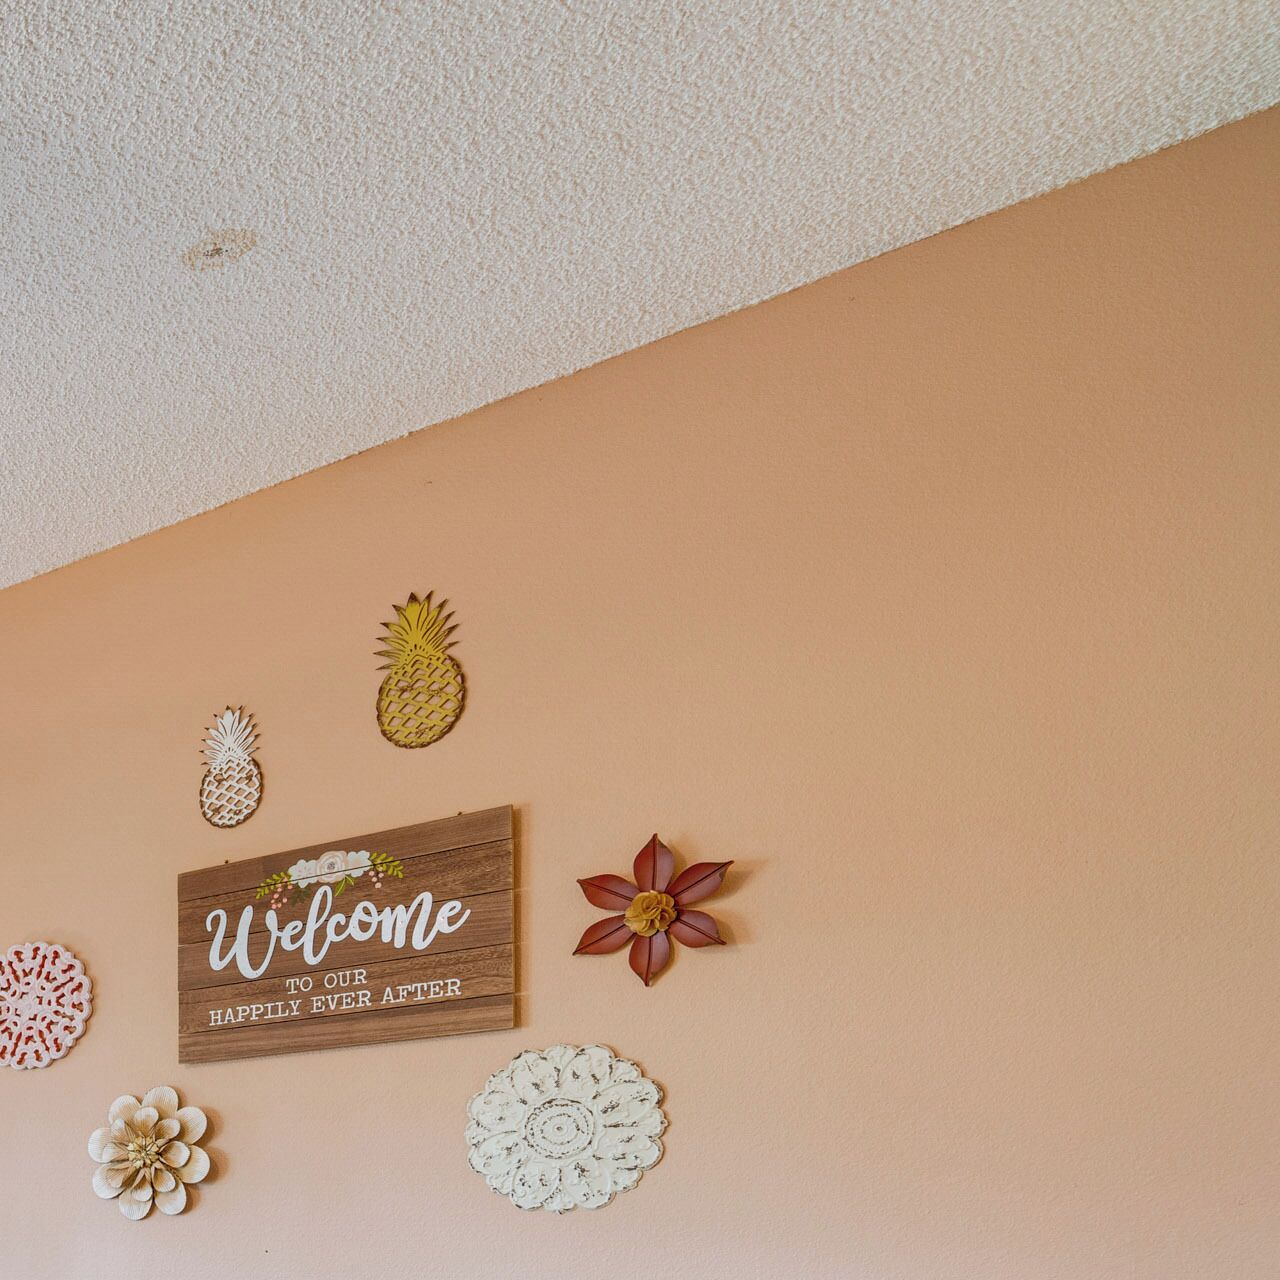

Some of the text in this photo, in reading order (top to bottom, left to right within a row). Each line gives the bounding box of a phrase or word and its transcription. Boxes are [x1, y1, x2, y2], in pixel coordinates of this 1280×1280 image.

[205, 885, 472, 979] Welcome
[208, 978, 462, 1026] HAPPILY EVER AFTER
[285, 968, 368, 995] TO OUR
